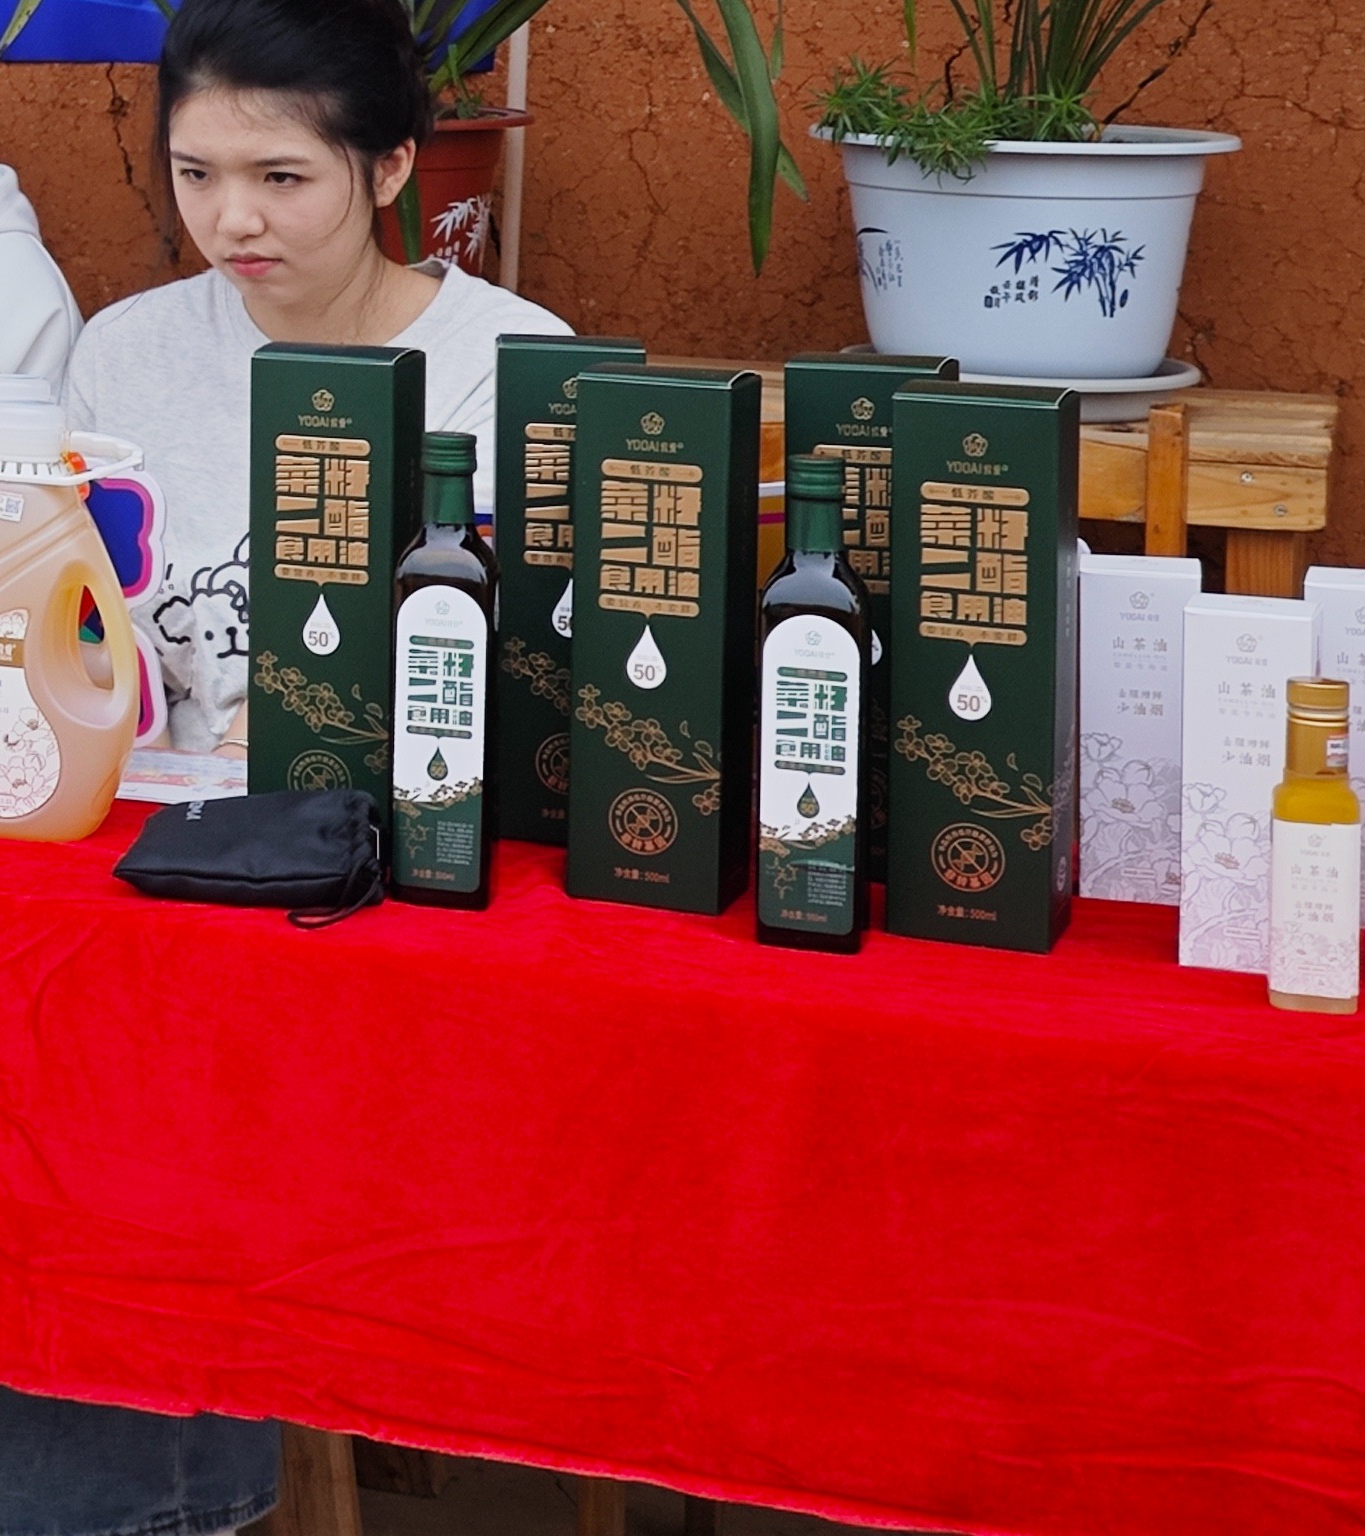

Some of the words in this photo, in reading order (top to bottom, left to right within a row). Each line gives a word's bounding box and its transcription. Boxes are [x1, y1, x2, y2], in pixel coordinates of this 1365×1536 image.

[1112, 636, 1168, 652] 山茶油
[1218, 681, 1276, 699] 山茶油
